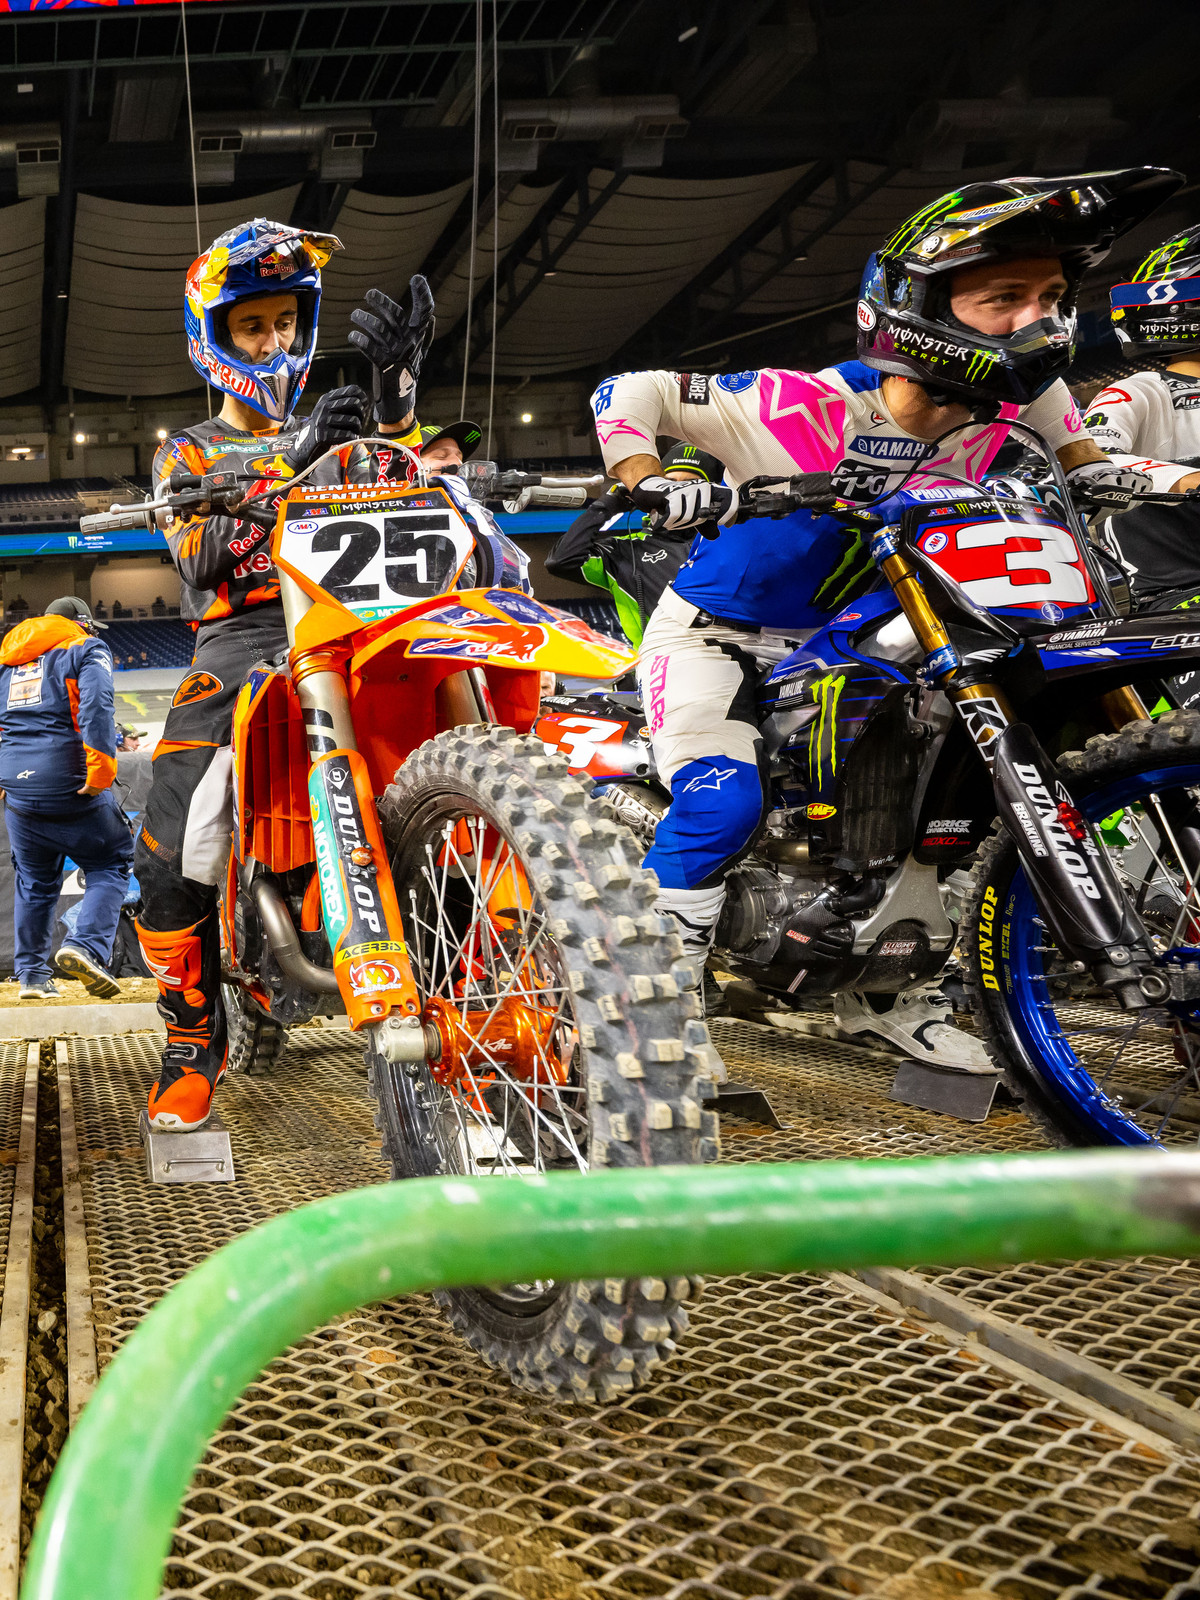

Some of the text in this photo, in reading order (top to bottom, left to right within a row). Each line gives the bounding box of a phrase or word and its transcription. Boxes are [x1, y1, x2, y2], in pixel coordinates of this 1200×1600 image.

[260, 262, 295, 278] Red Bull
[1140, 323, 1200, 333] MONSTE
[887, 324, 970, 361] MONSTER
[893, 342, 950, 366] ENERGY
[191, 339, 257, 398] Red Bull
[220, 445, 265, 453] MOTOREX
[672, 458, 700, 466] Kawasaki
[831, 465, 887, 497] PPG
[1093, 486, 1133, 503] ARC
[303, 499, 434, 516] AMA MONSTER AMA
[927, 506, 957, 517] AMA
[969, 503, 1025, 512] MONSTER
[293, 522, 313, 531] AMA
[228, 523, 266, 557] Red
[928, 534, 944, 551] AMA
[233, 552, 278, 580] Re
[311, 514, 458, 604] 25
[954, 521, 1091, 609] 3
[1062, 627, 1108, 642] YAMAHA
[1046, 640, 1102, 651] FINANCIAL SERVICES
[543, 717, 624, 770] 3
[807, 807, 836, 817] FMF
[1013, 803, 1049, 858] BRAKING
[332, 794, 382, 934] DUOP
[868, 858, 886, 868] Twin
[312, 820, 345, 930] MOTOREX
[882, 941, 918, 950] LIGHT
[978, 885, 1000, 992] DUNLOP
[1001, 922, 1011, 960] EXCEL
[342, 943, 403, 962] ACERBIS
